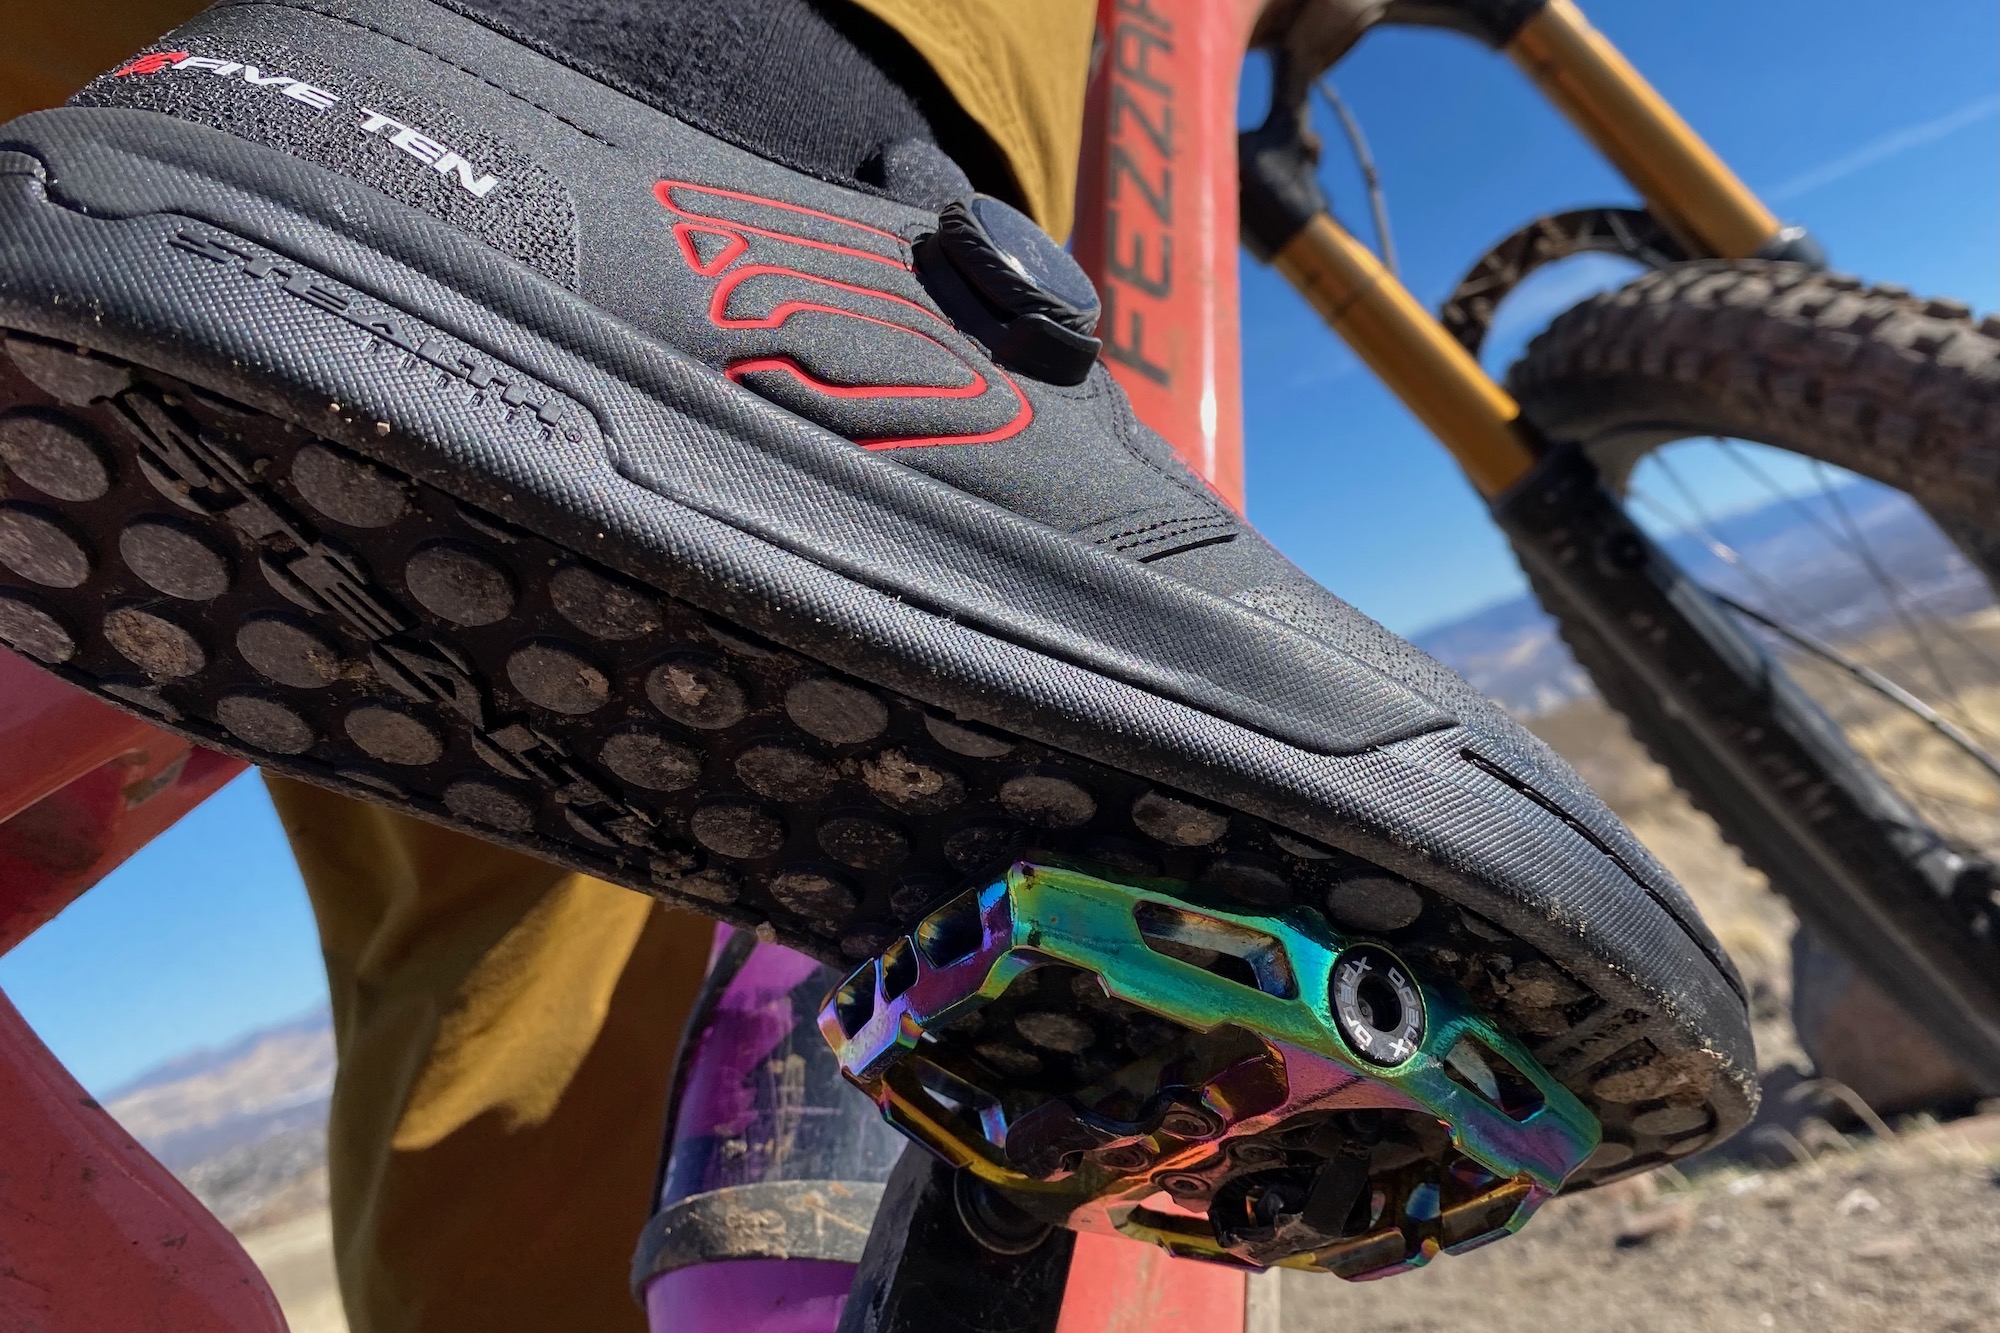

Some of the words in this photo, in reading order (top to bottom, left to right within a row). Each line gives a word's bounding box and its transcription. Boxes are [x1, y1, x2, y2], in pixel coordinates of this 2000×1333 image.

[171, 56, 342, 109] FIVE
[360, 107, 498, 198] TEN
[167, 228, 564, 428] STEALTH
